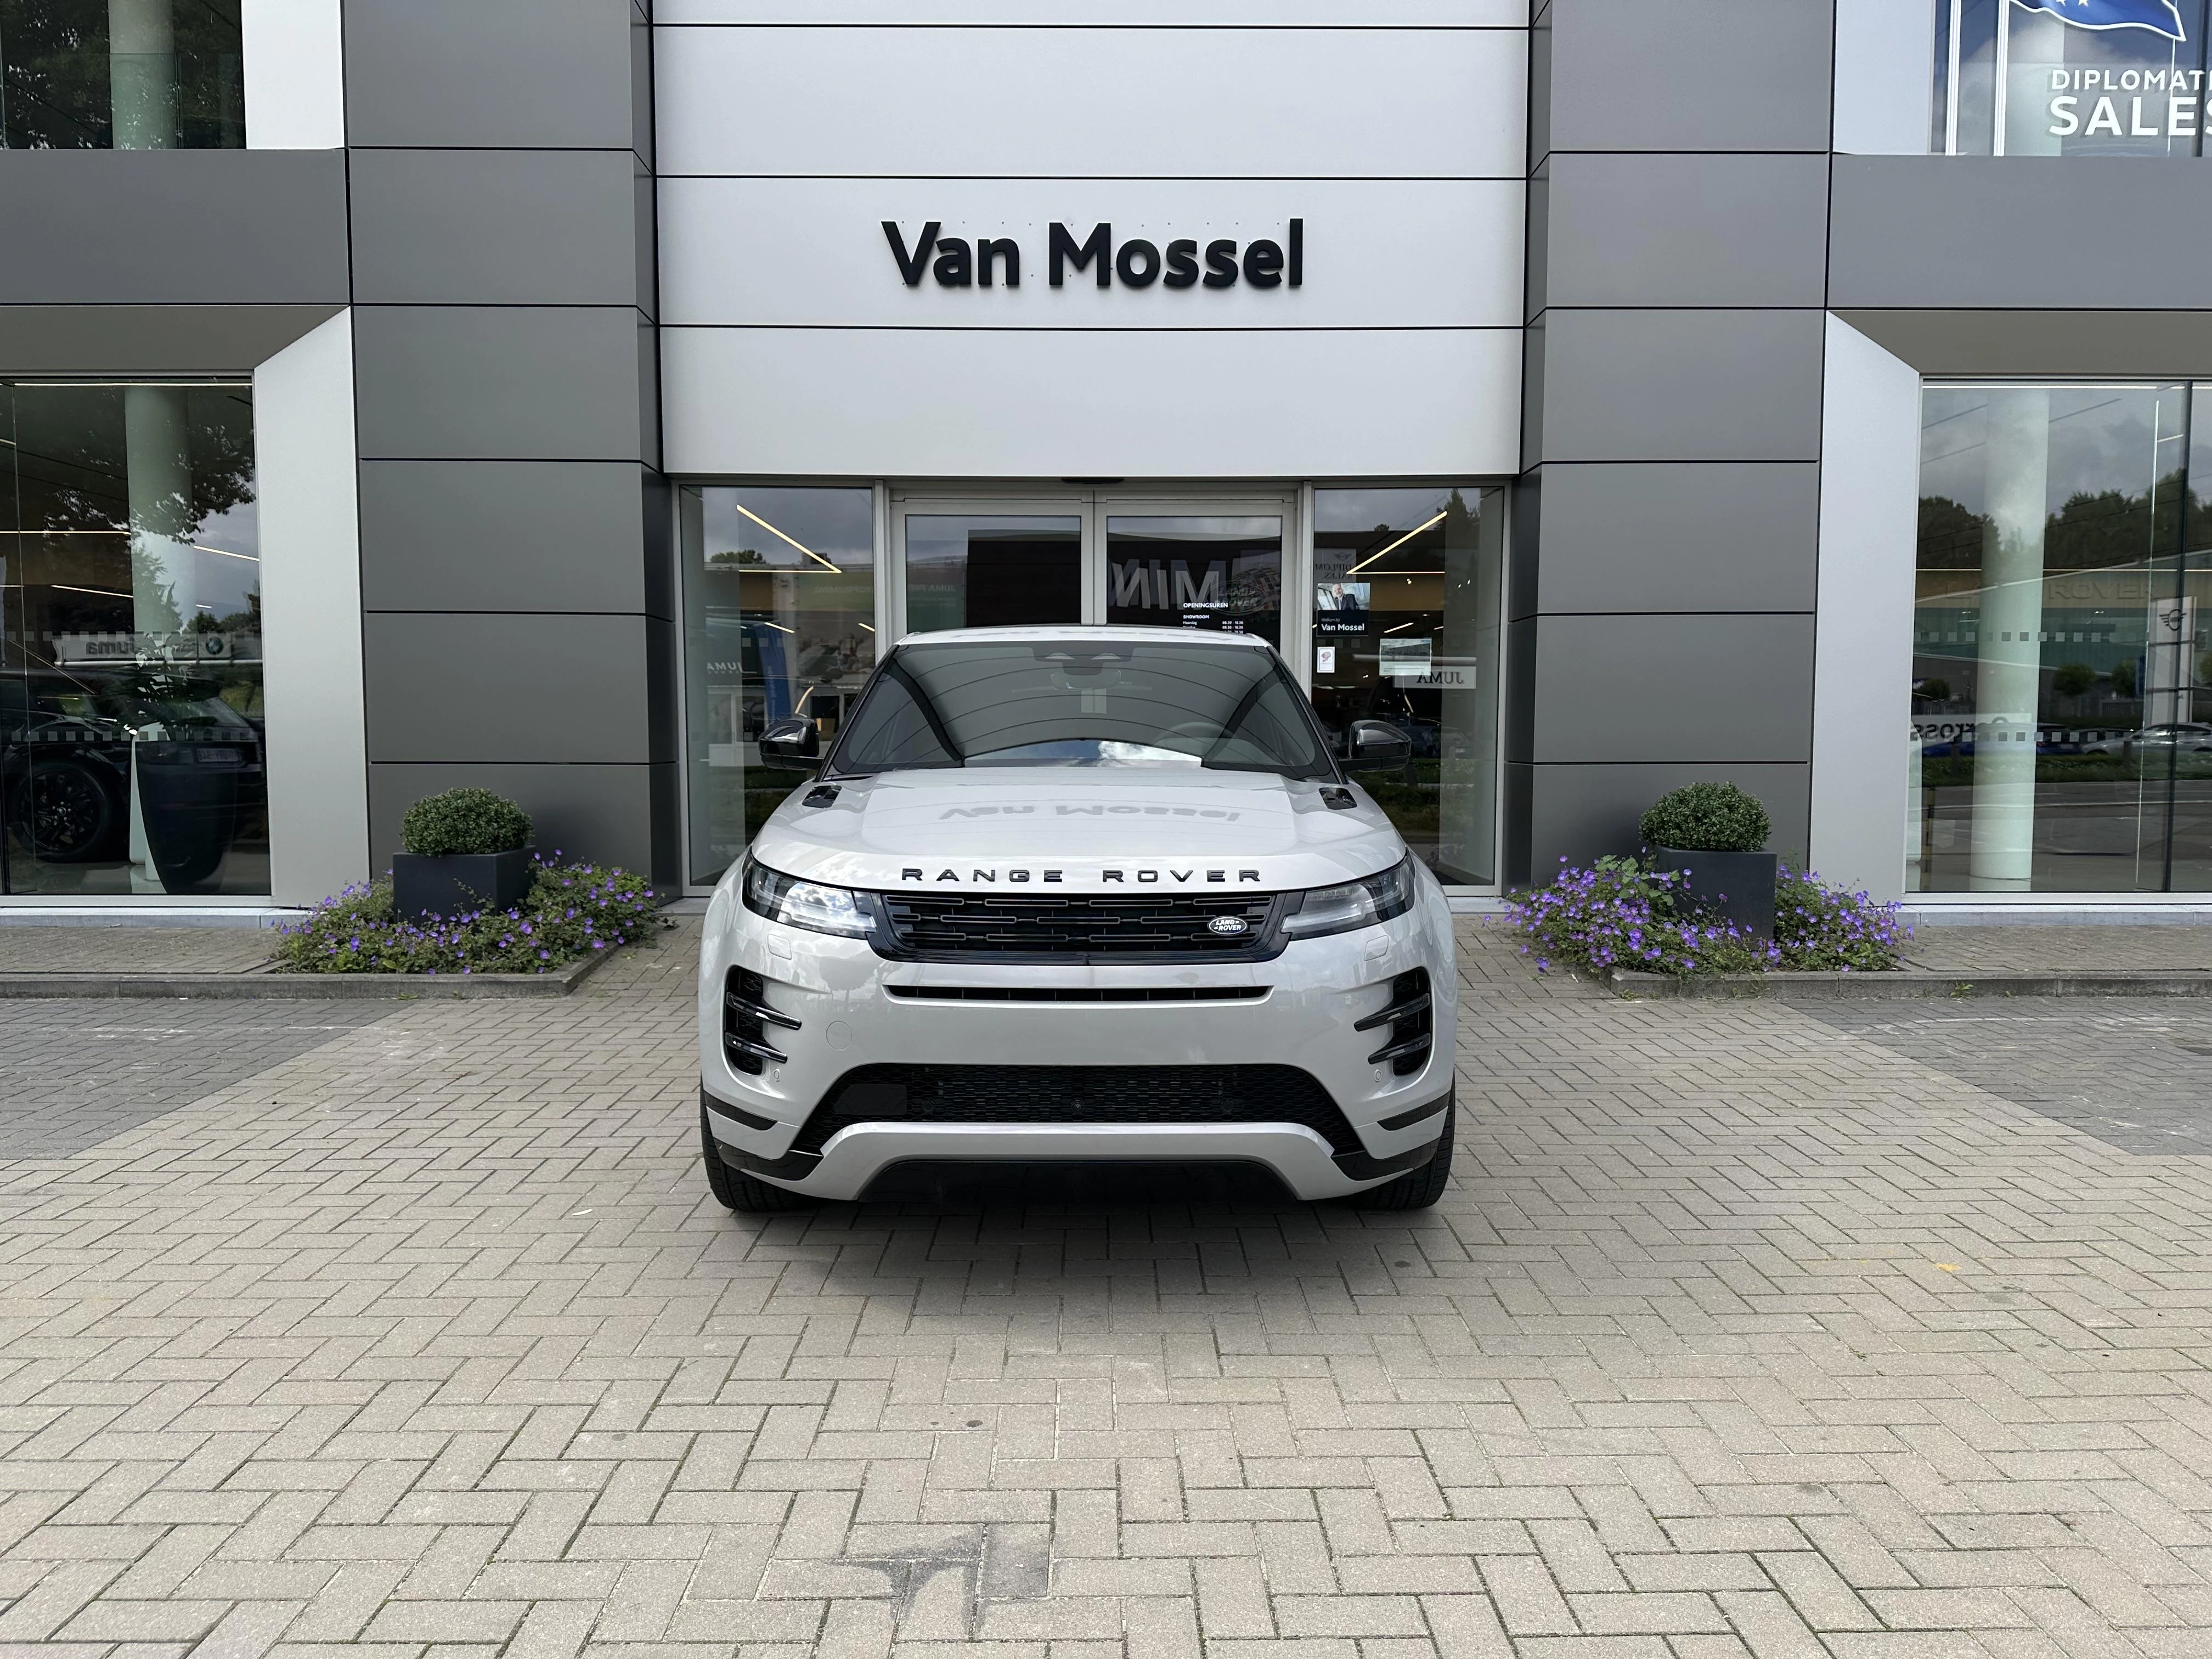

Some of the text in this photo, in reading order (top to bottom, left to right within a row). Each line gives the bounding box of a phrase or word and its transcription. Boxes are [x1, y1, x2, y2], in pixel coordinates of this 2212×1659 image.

[2049, 95, 2212, 136] SALE
[881, 218, 1303, 287] Van Mossel
[901, 868, 1261, 882] RANGE ROVER
